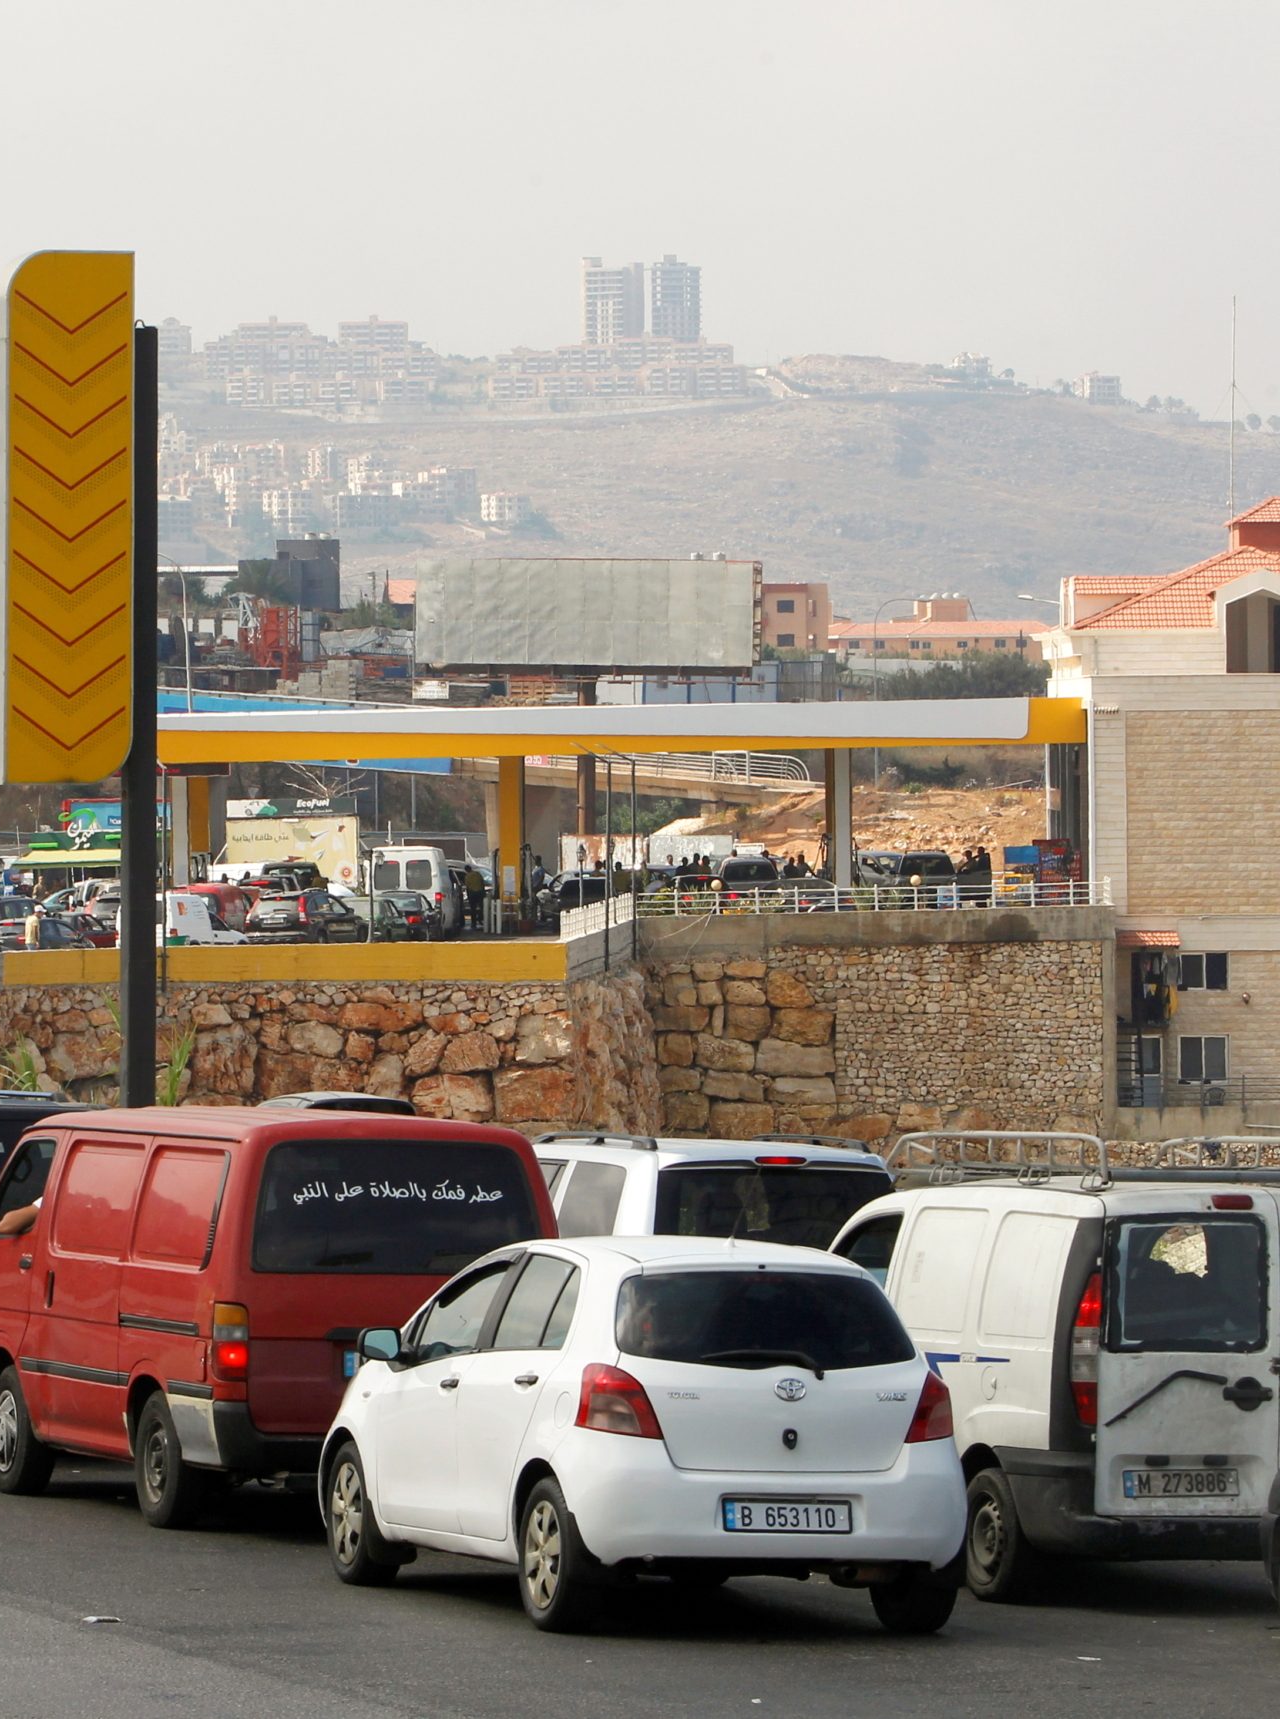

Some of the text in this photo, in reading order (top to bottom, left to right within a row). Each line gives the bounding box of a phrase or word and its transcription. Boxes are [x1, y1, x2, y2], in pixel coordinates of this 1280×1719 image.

[296, 798, 330, 809] EcoFuel
[293, 1181, 329, 1205] النبي
[334, 1181, 364, 1201] على
[432, 1179, 465, 1200] فمك
[469, 1185, 503, 1203] عطر
[1137, 1472, 1227, 1494] M 273886
[740, 1505, 836, 1529] B 653110
